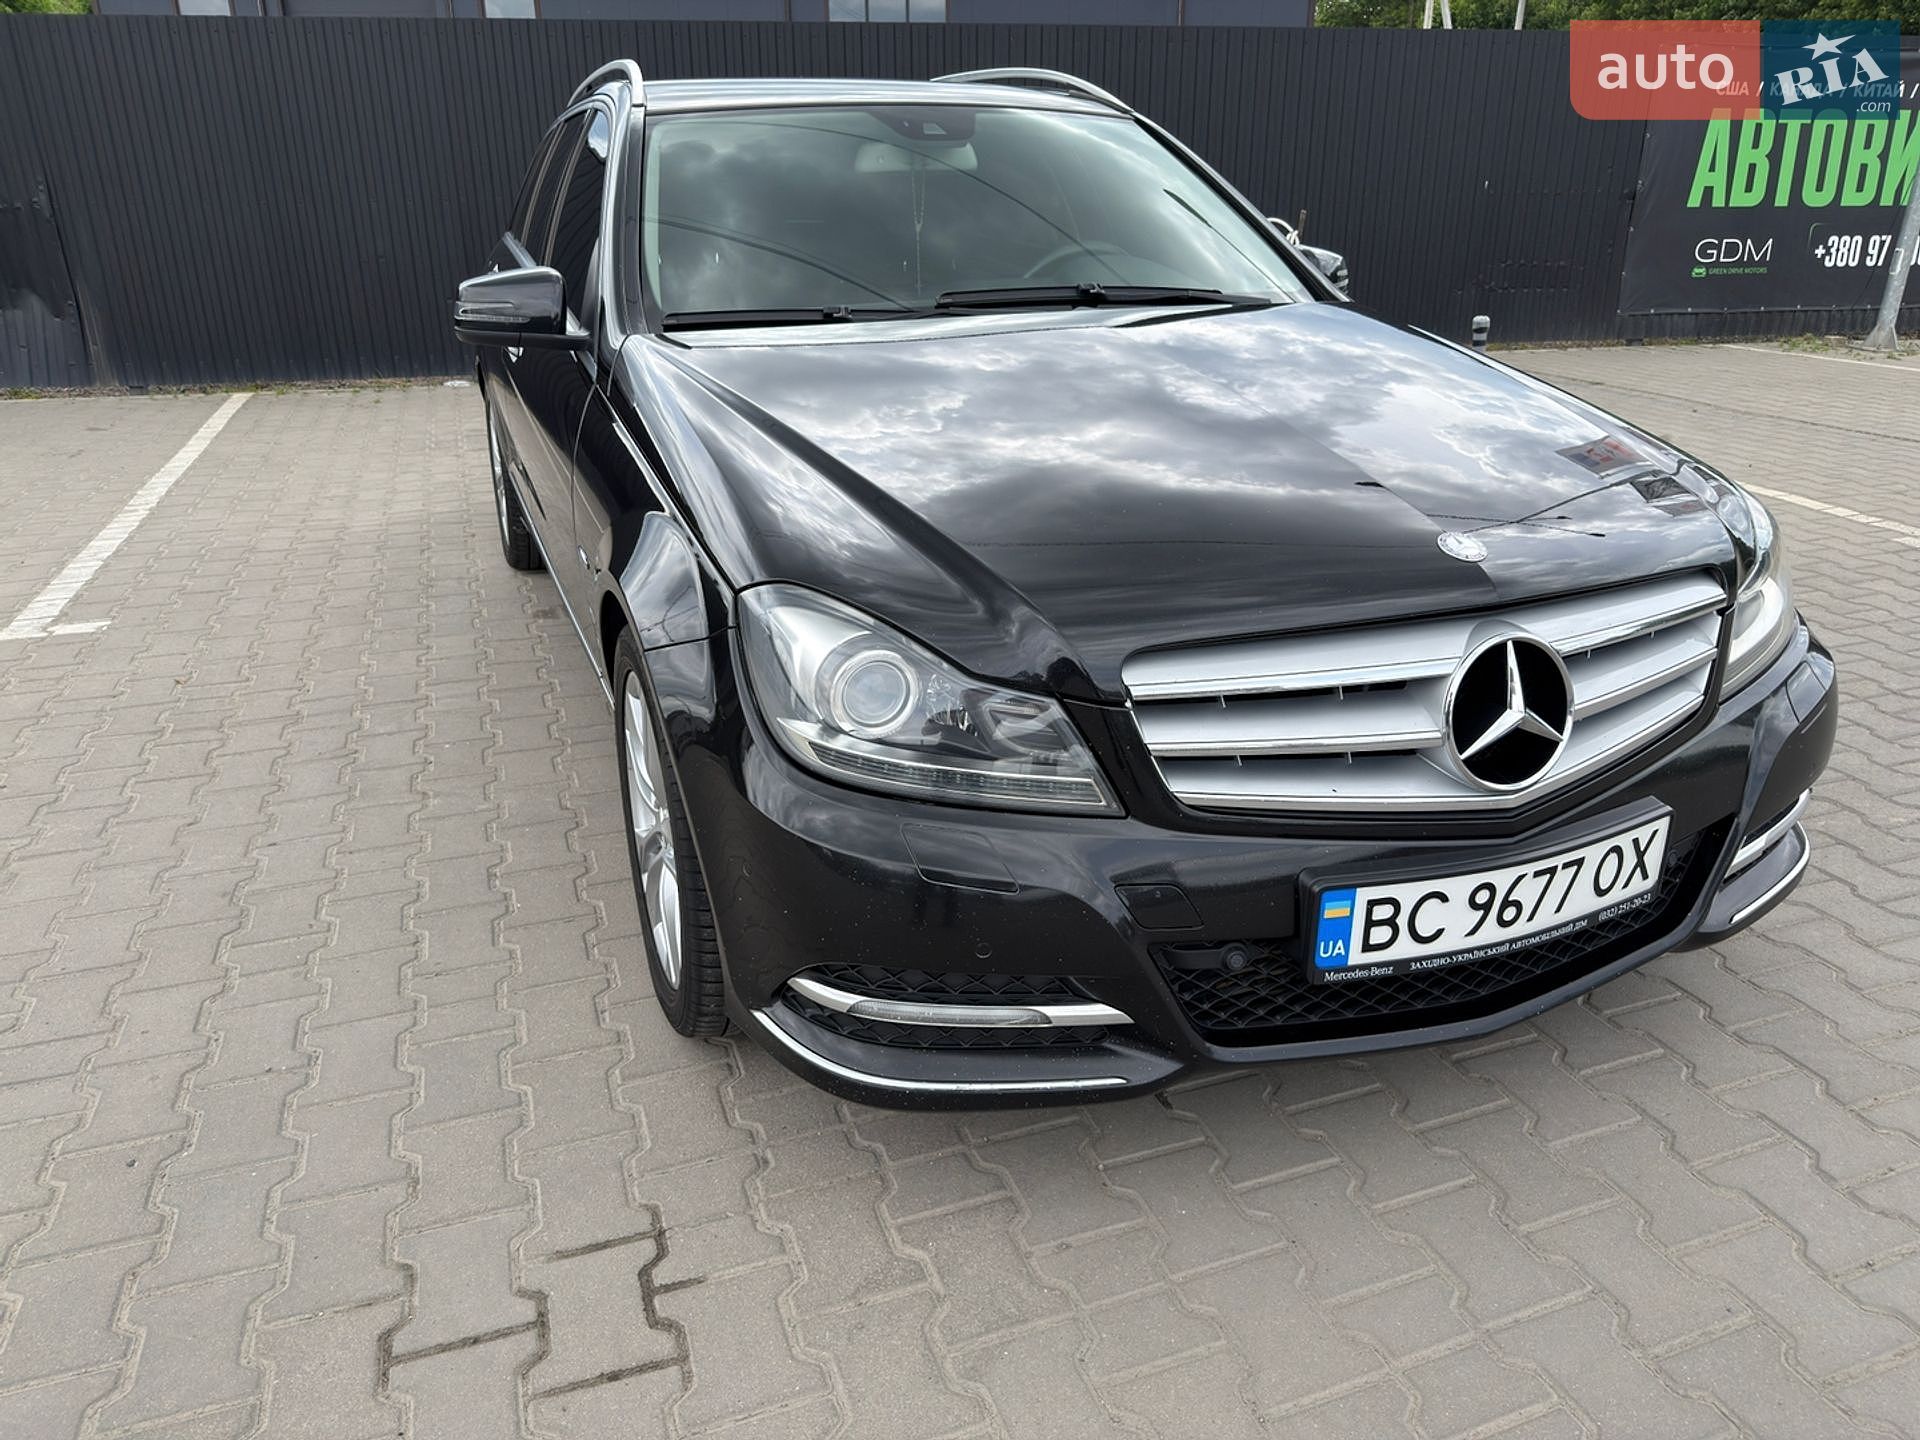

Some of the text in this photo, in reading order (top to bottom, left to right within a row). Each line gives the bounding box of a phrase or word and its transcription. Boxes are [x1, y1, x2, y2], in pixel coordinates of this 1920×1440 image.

[1716, 82, 1750, 96] США
[1854, 80, 1905, 97] КИТАЙ
[1695, 238, 1773, 263] GDM
[1814, 235, 1863, 267] +380
[1866, 234, 1892, 267] 97
[1708, 266, 1727, 275] GREEN
[1744, 265, 1768, 274] MOTORS
[1320, 829, 1660, 958] UA BC 9677 OX
[1324, 966, 1395, 982] Mercedes-Benz
